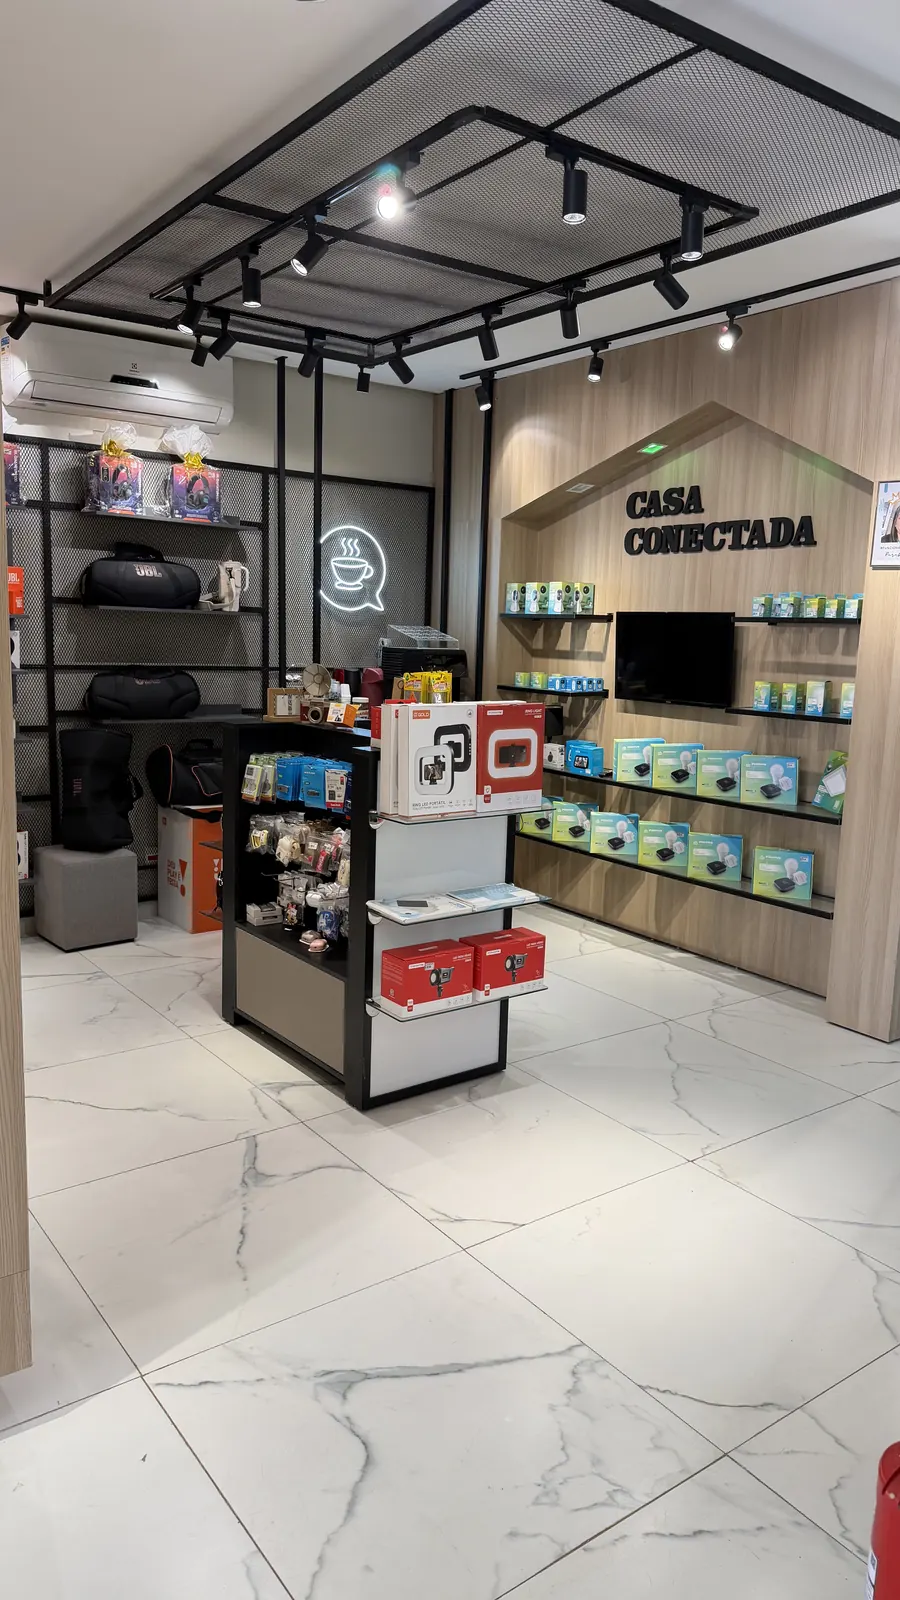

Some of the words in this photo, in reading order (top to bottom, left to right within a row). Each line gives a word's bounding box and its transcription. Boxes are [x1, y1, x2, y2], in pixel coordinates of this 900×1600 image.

[626, 486, 704, 519] CASA
[624, 516, 817, 556] CONECTADA
[133, 563, 163, 578] JBL
